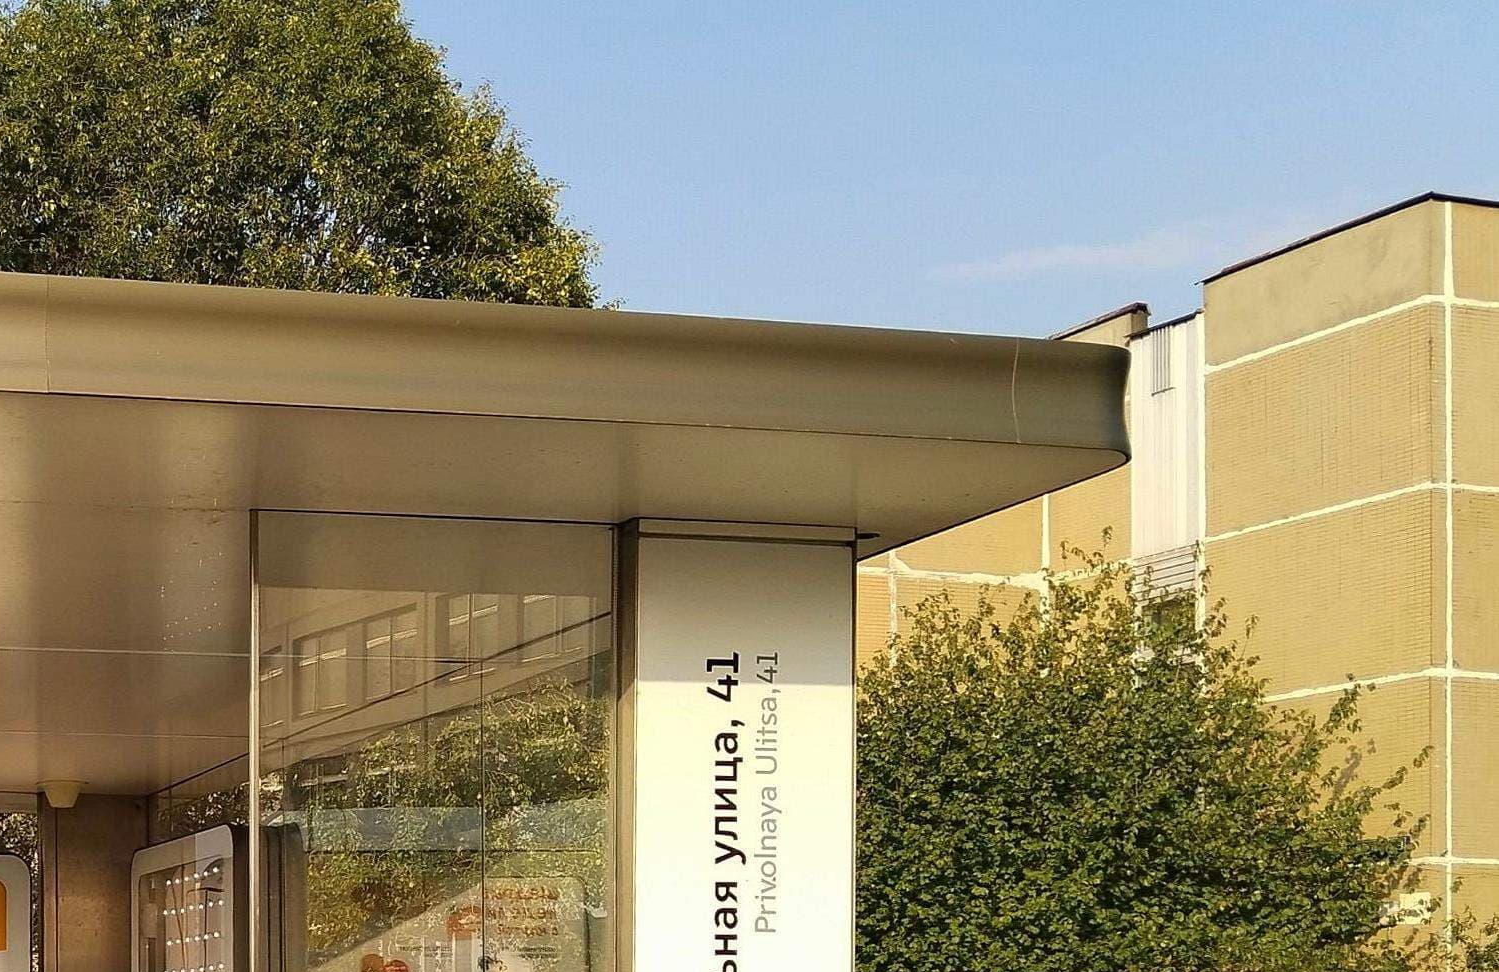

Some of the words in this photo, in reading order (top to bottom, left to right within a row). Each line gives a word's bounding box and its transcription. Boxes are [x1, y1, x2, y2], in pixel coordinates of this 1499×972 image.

[707, 651, 740, 702] 41
[714, 719, 746, 864] улица,
[755, 786, 782, 933] Privolnaya
